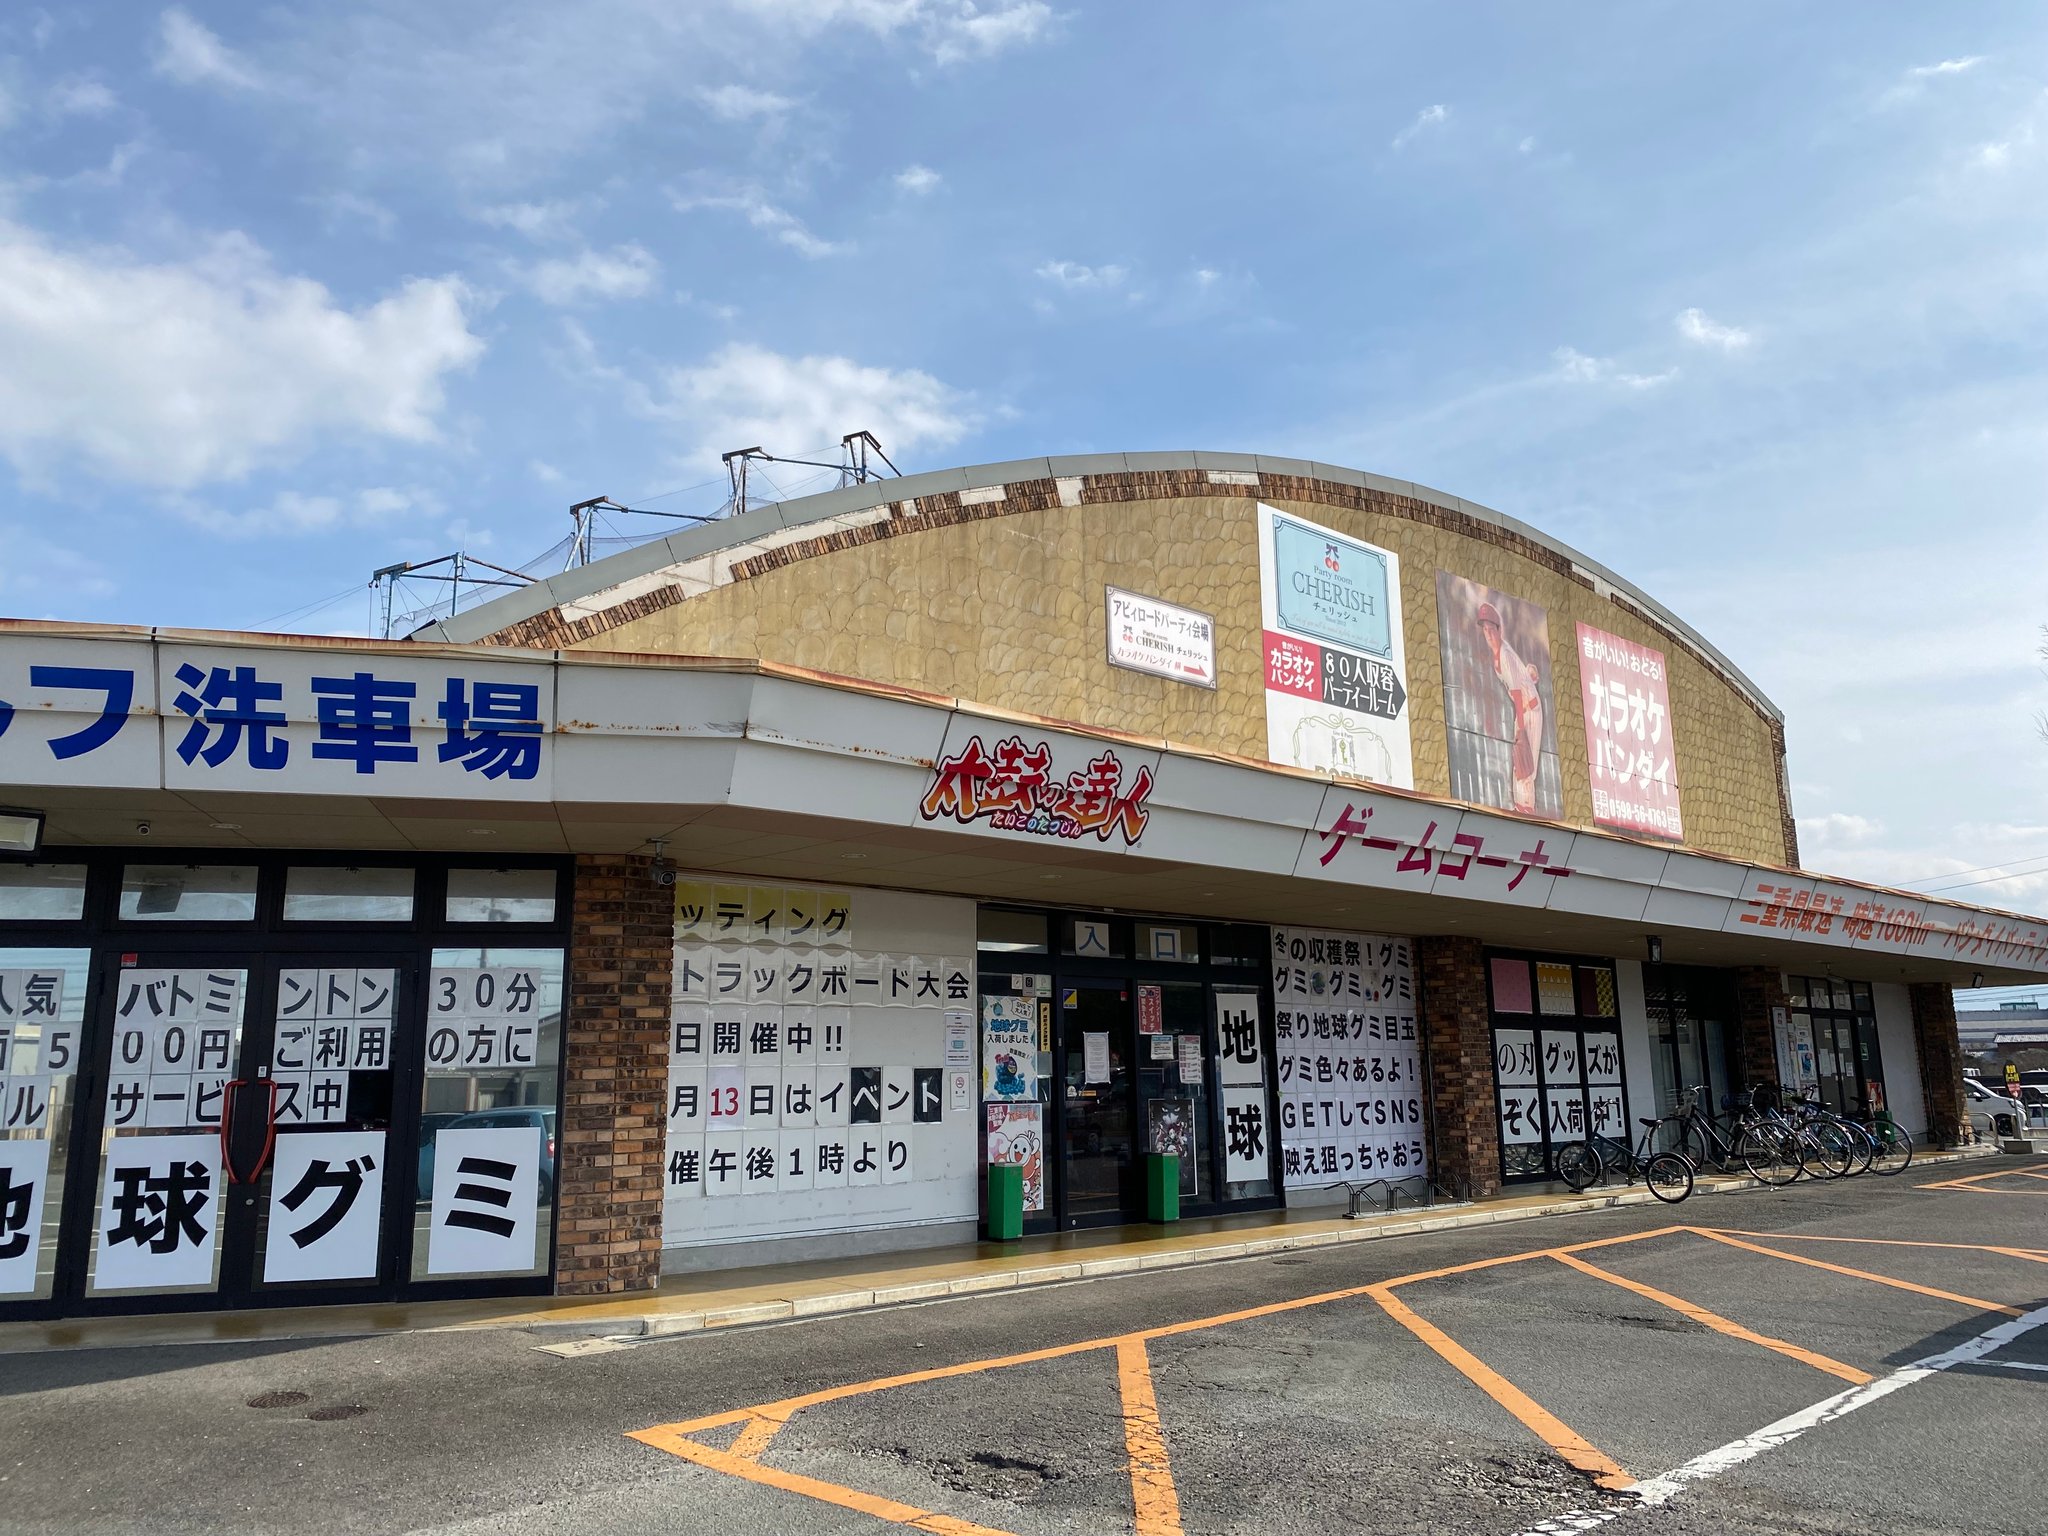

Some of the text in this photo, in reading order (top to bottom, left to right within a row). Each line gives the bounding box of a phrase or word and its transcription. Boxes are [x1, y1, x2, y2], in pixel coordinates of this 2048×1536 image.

[1291, 570, 1376, 617] CHERISH
[1314, 565, 1353, 586] Party room
[1113, 599, 1209, 643] アビィロードパーティ会場
[1312, 601, 1358, 623] チェリッシュ
[1136, 634, 1208, 662] CHERISH チェリッシュ
[1270, 648, 1315, 675] カラオケ
[1583, 636, 1662, 682] 音がいい! おどる!
[1271, 668, 1315, 693] バンダイ
[1325, 652, 1395, 692] 80人収容
[1323, 675, 1397, 716] パーティールーム
[1589, 674, 1665, 745] カラオケ
[0, 662, 544, 781] フ洗車場
[1595, 738, 1670, 796] バンダイ
[921, 736, 1154, 846] 太鼓の達人
[990, 810, 1084, 840] たいこのたつじん
[1609, 798, 1668, 829] 0598-56-4763
[1319, 803, 1577, 892] ゲームコーナー
[1740, 883, 1846, 935] 三重県最速
[1943, 918, 2048, 967] バンダイバッティン
[1274, 931, 1410, 969] 冬の収穫祭!グミ
[436, 970, 537, 1014] 30分
[682, 959, 971, 1000] トラックボード大会
[1274, 965, 1411, 1000] グミ グミ グミ
[277, 1024, 387, 1066] ご利用
[427, 1024, 533, 1064] の方に
[676, 1021, 843, 1055] 日開催中!!
[990, 1018, 1029, 1033] 地球グミ
[1276, 1009, 1416, 1042] 祭り地球グミ目玉
[1279, 1054, 1414, 1083] グミ色々あるよ!
[1498, 1040, 1619, 1077] の刃グッズが
[670, 1081, 940, 1119] 月13日はイベント
[1221, 1009, 1265, 1162] 地球
[1282, 1098, 1420, 1130] GETしてSNS
[1503, 1096, 1623, 1136] ぞく入荷中!
[668, 1140, 909, 1185] 催午後1時より
[1285, 1140, 1424, 1177] 映え狙っちゃおう
